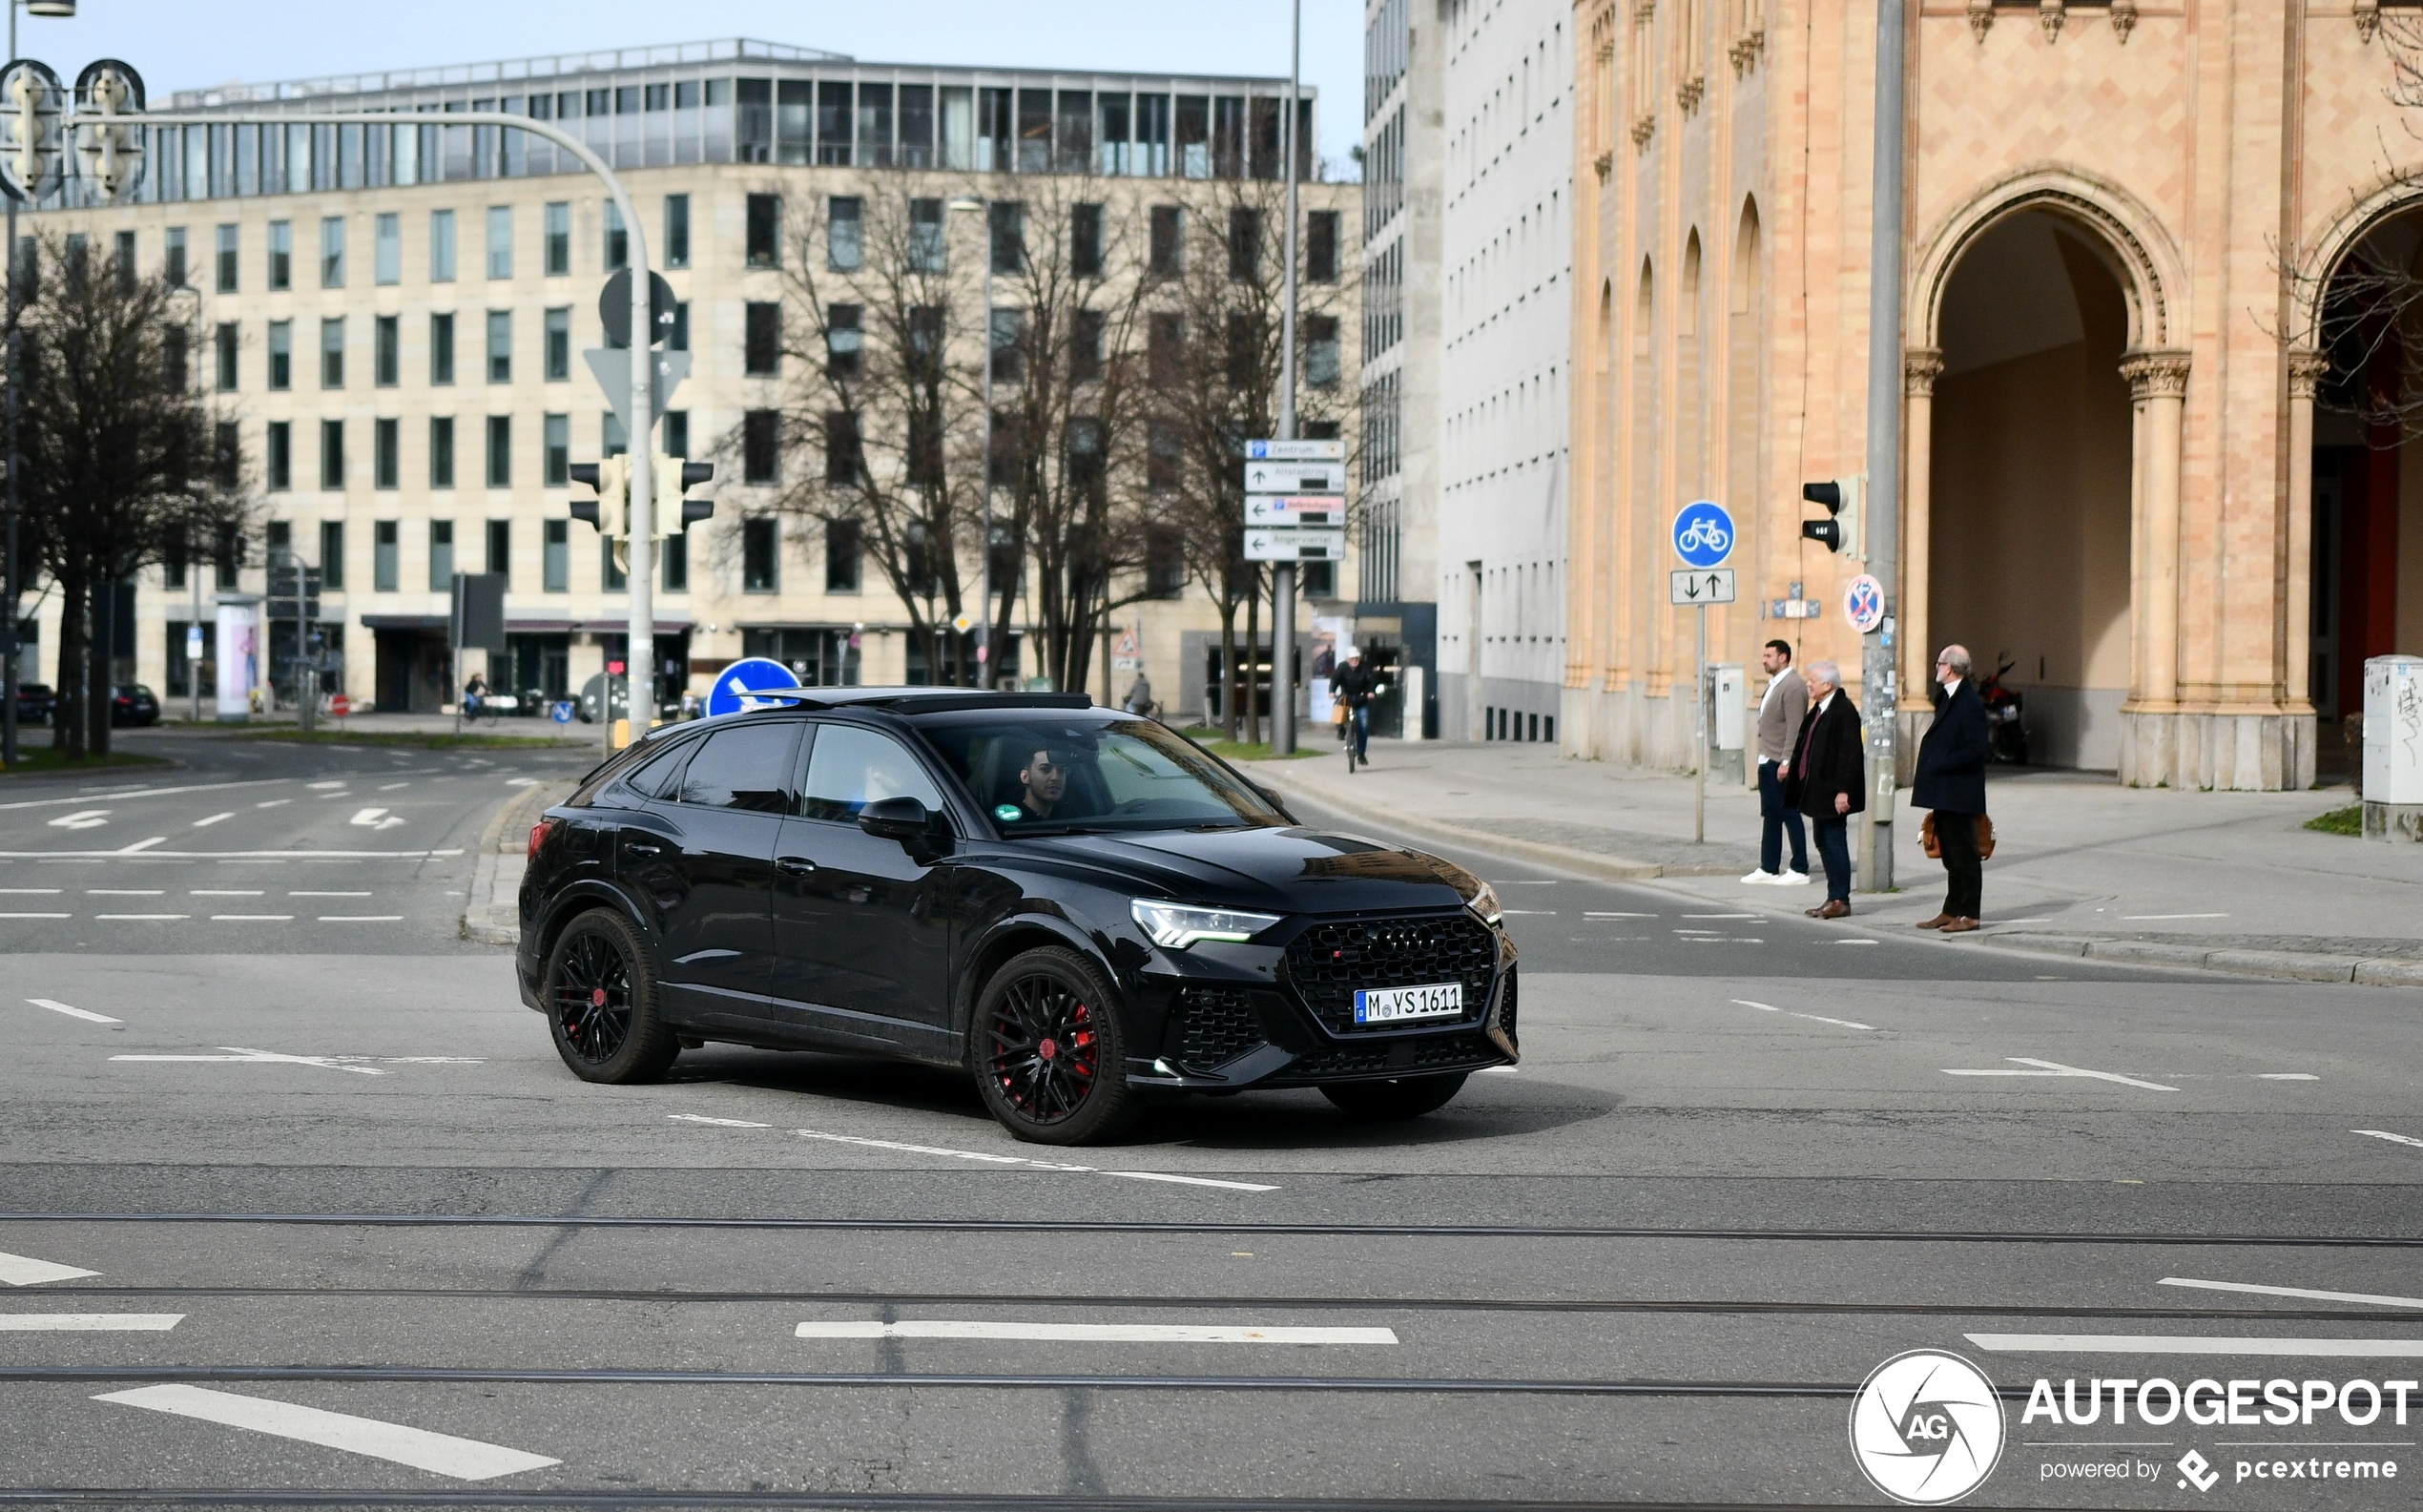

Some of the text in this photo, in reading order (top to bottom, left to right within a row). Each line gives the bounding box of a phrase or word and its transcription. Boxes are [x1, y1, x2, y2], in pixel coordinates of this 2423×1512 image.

[1272, 445, 1315, 454] Zentrum
[1274, 535, 1332, 546] Angerviertel
[1368, 994, 1380, 1017] M
[1393, 991, 1416, 1015] YS
[1419, 986, 1460, 1013] 1611
